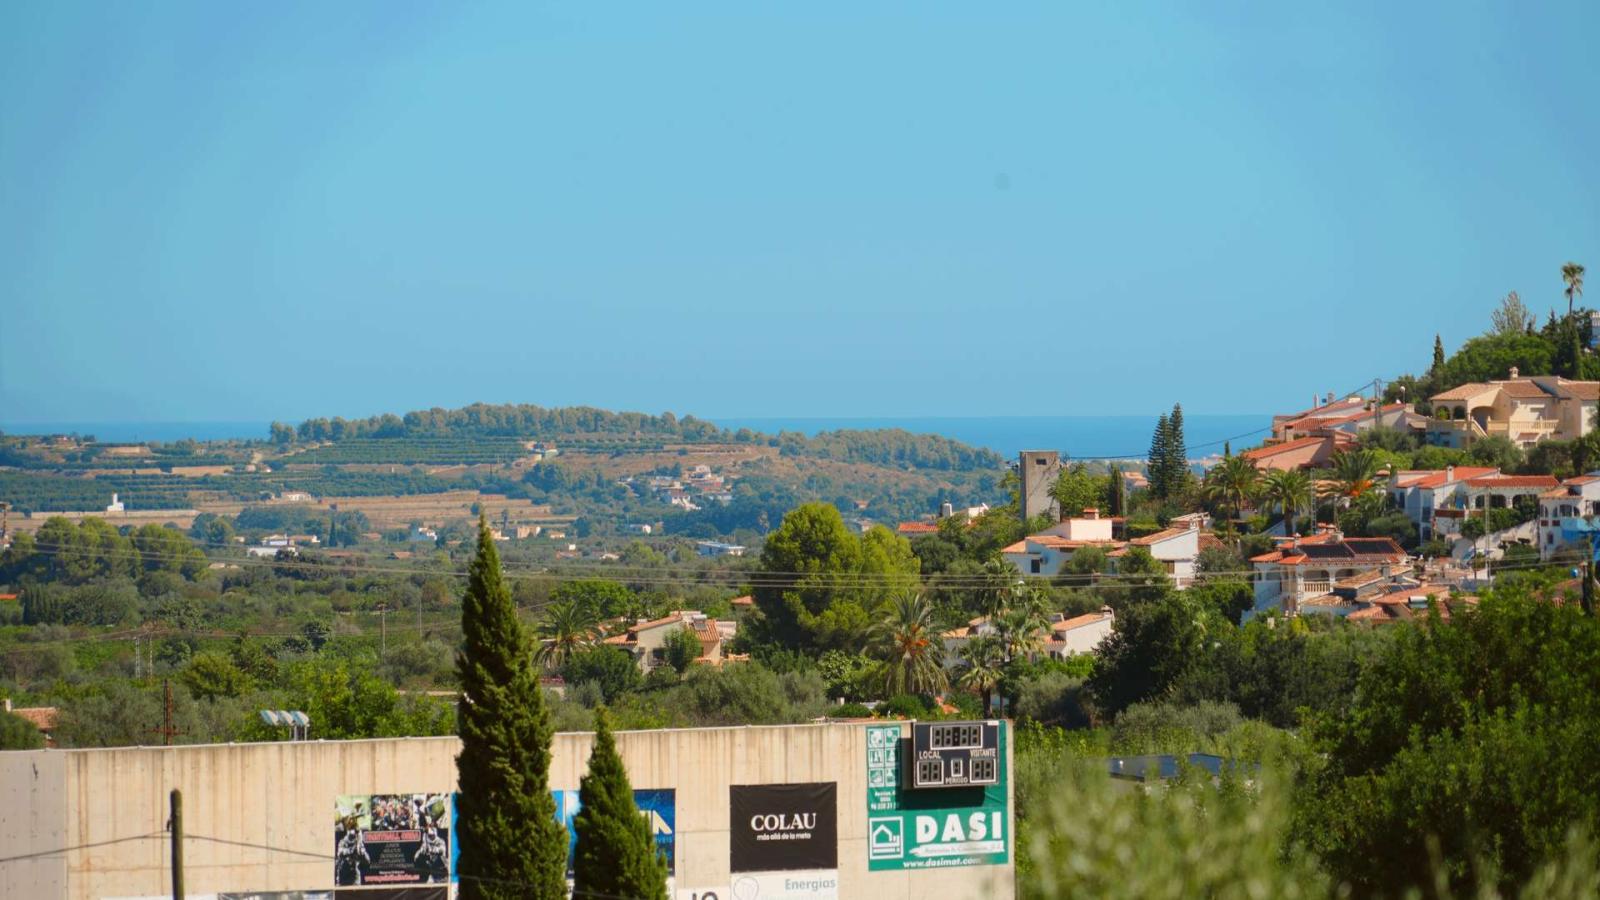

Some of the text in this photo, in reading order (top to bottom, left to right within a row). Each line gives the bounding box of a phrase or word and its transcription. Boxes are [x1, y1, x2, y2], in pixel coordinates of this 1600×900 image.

[919, 748, 996, 760] LOCAL VISITANTE
[750, 812, 817, 831] COLAU
[916, 811, 1002, 843] DASI
